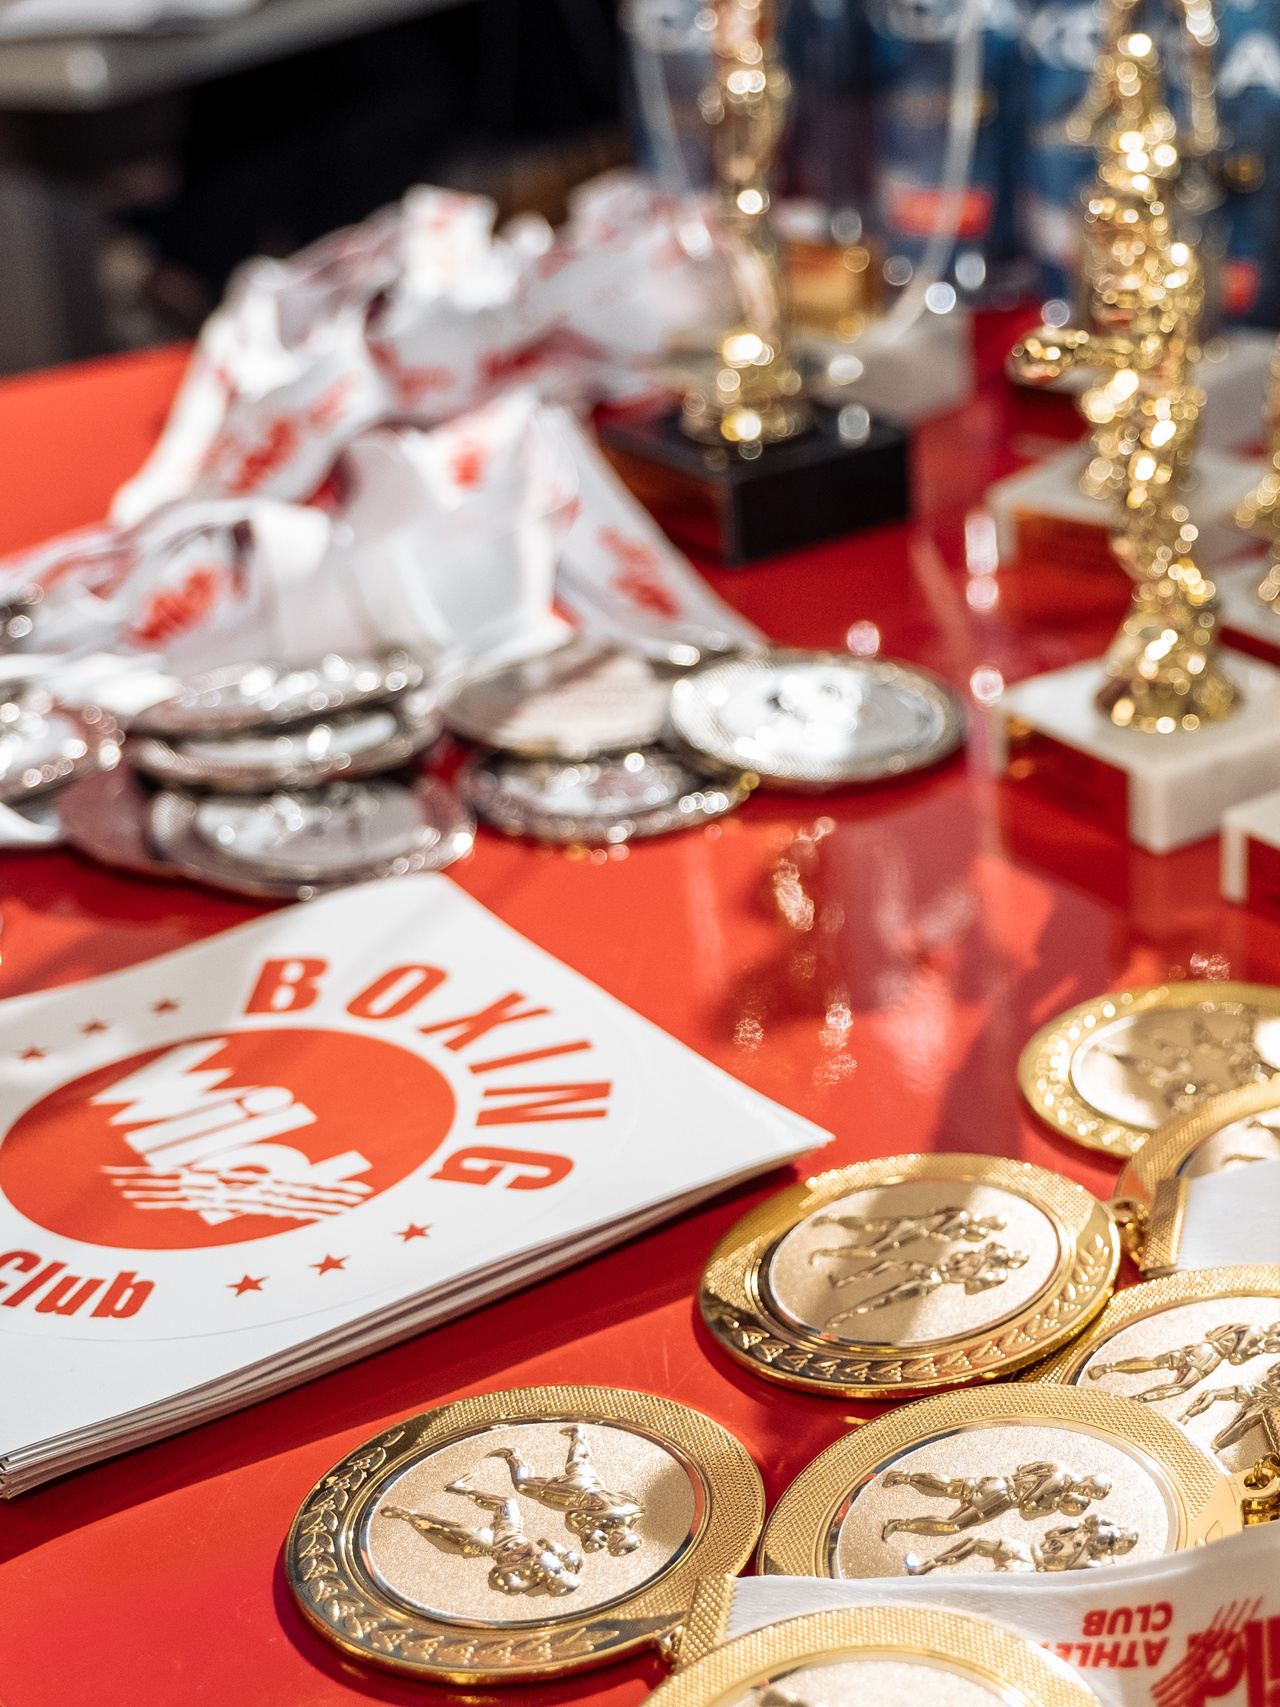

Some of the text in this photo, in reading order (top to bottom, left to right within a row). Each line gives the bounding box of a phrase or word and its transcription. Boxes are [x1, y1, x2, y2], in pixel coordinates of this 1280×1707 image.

[243, 957, 613, 1191] BOXING
[0, 1249, 156, 1319] Club
[1082, 1600, 1173, 1637] CLUB
[1041, 1636, 1171, 1670] ATHLE
